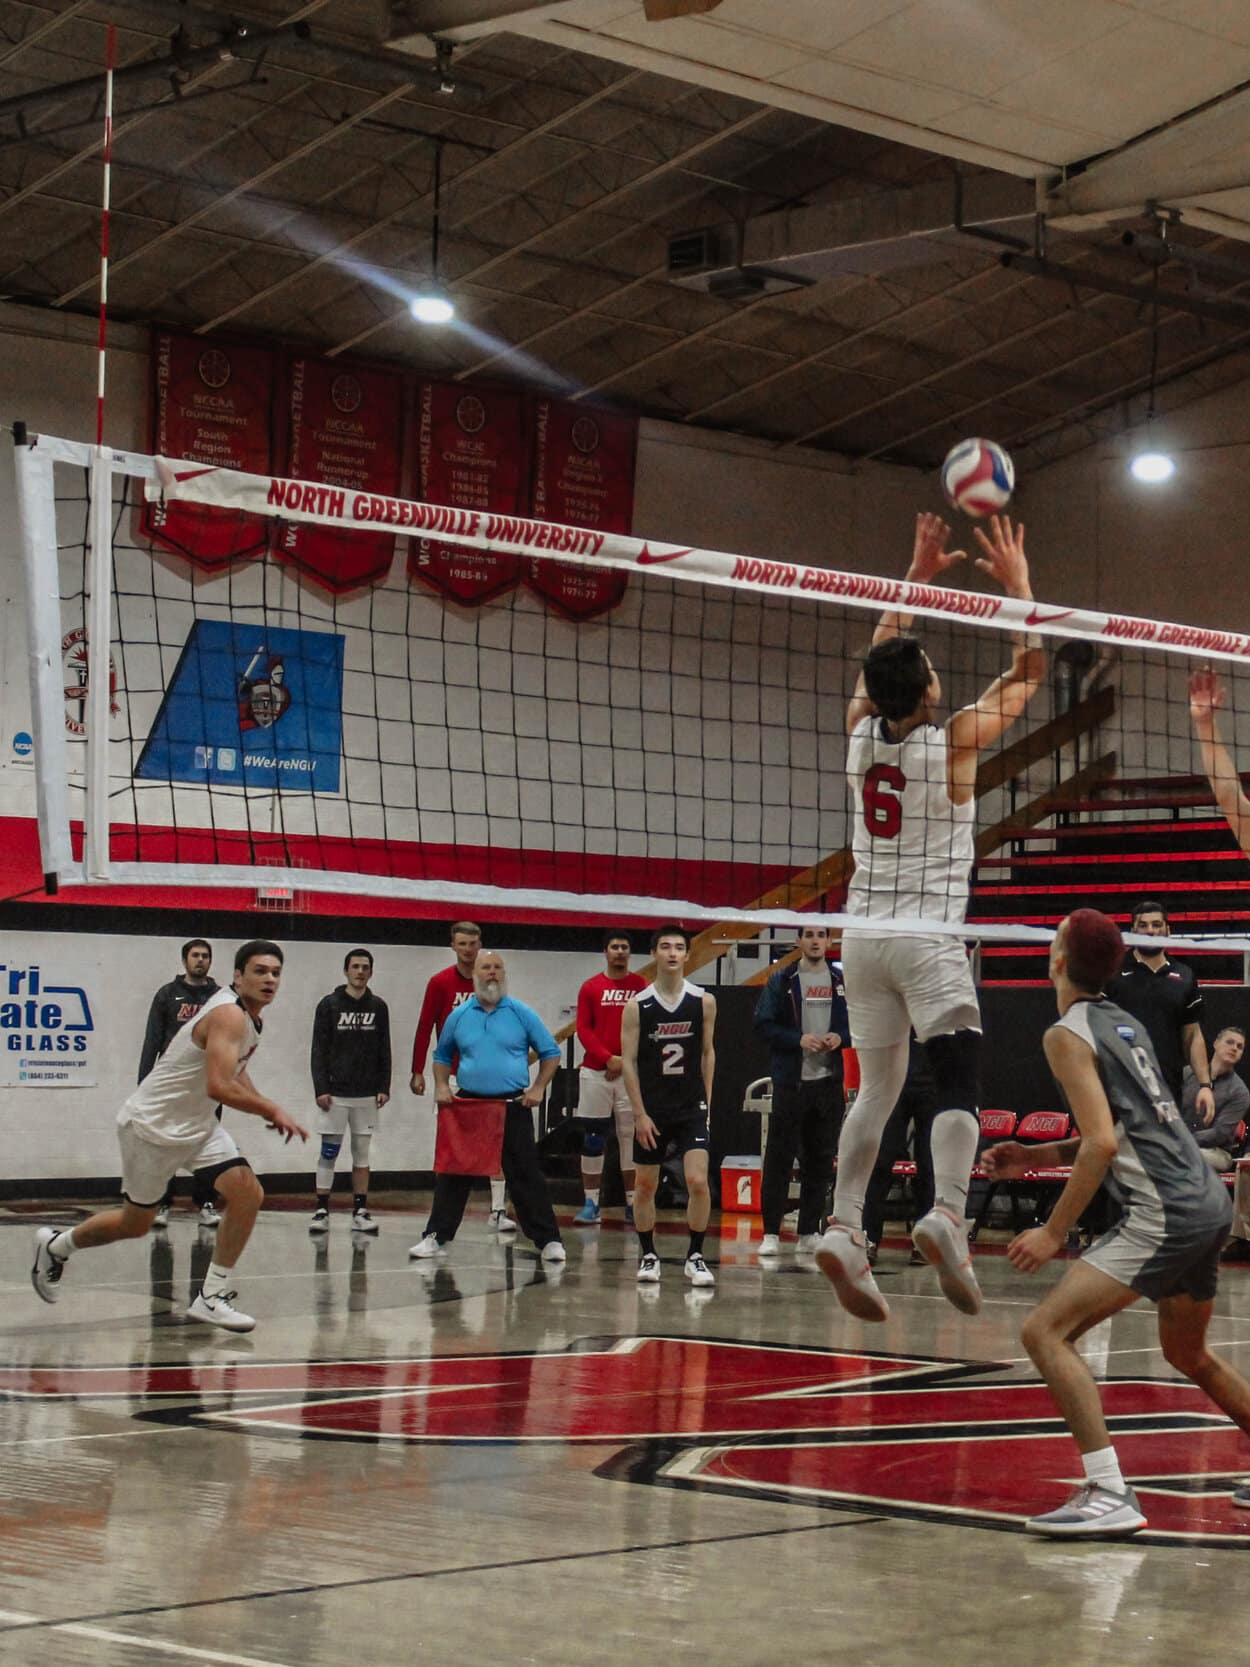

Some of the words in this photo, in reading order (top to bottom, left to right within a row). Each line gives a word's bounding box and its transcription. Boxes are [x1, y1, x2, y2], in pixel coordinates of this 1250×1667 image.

[197, 428, 229, 440] South
[193, 440, 231, 454] Region
[267, 479, 346, 518] NORTH
[352, 494, 481, 537] GREENVILLE
[485, 515, 605, 556] UNIVERSITY
[731, 557, 797, 588] NORTH
[799, 569, 903, 604] GREENVILLE
[904, 586, 1002, 618] UNIVERSITY
[1101, 616, 1157, 641] NORTH
[1158, 625, 1242, 653] GREENVILLE
[243, 755, 317, 772] #WeAreNGU
[862, 763, 906, 840] 6
[602, 989, 637, 1001] NGU
[338, 1012, 376, 1025] NGU
[658, 1022, 692, 1035] NGU
[8, 1034, 87, 1052] GLASS
[662, 1043, 685, 1075] 2
